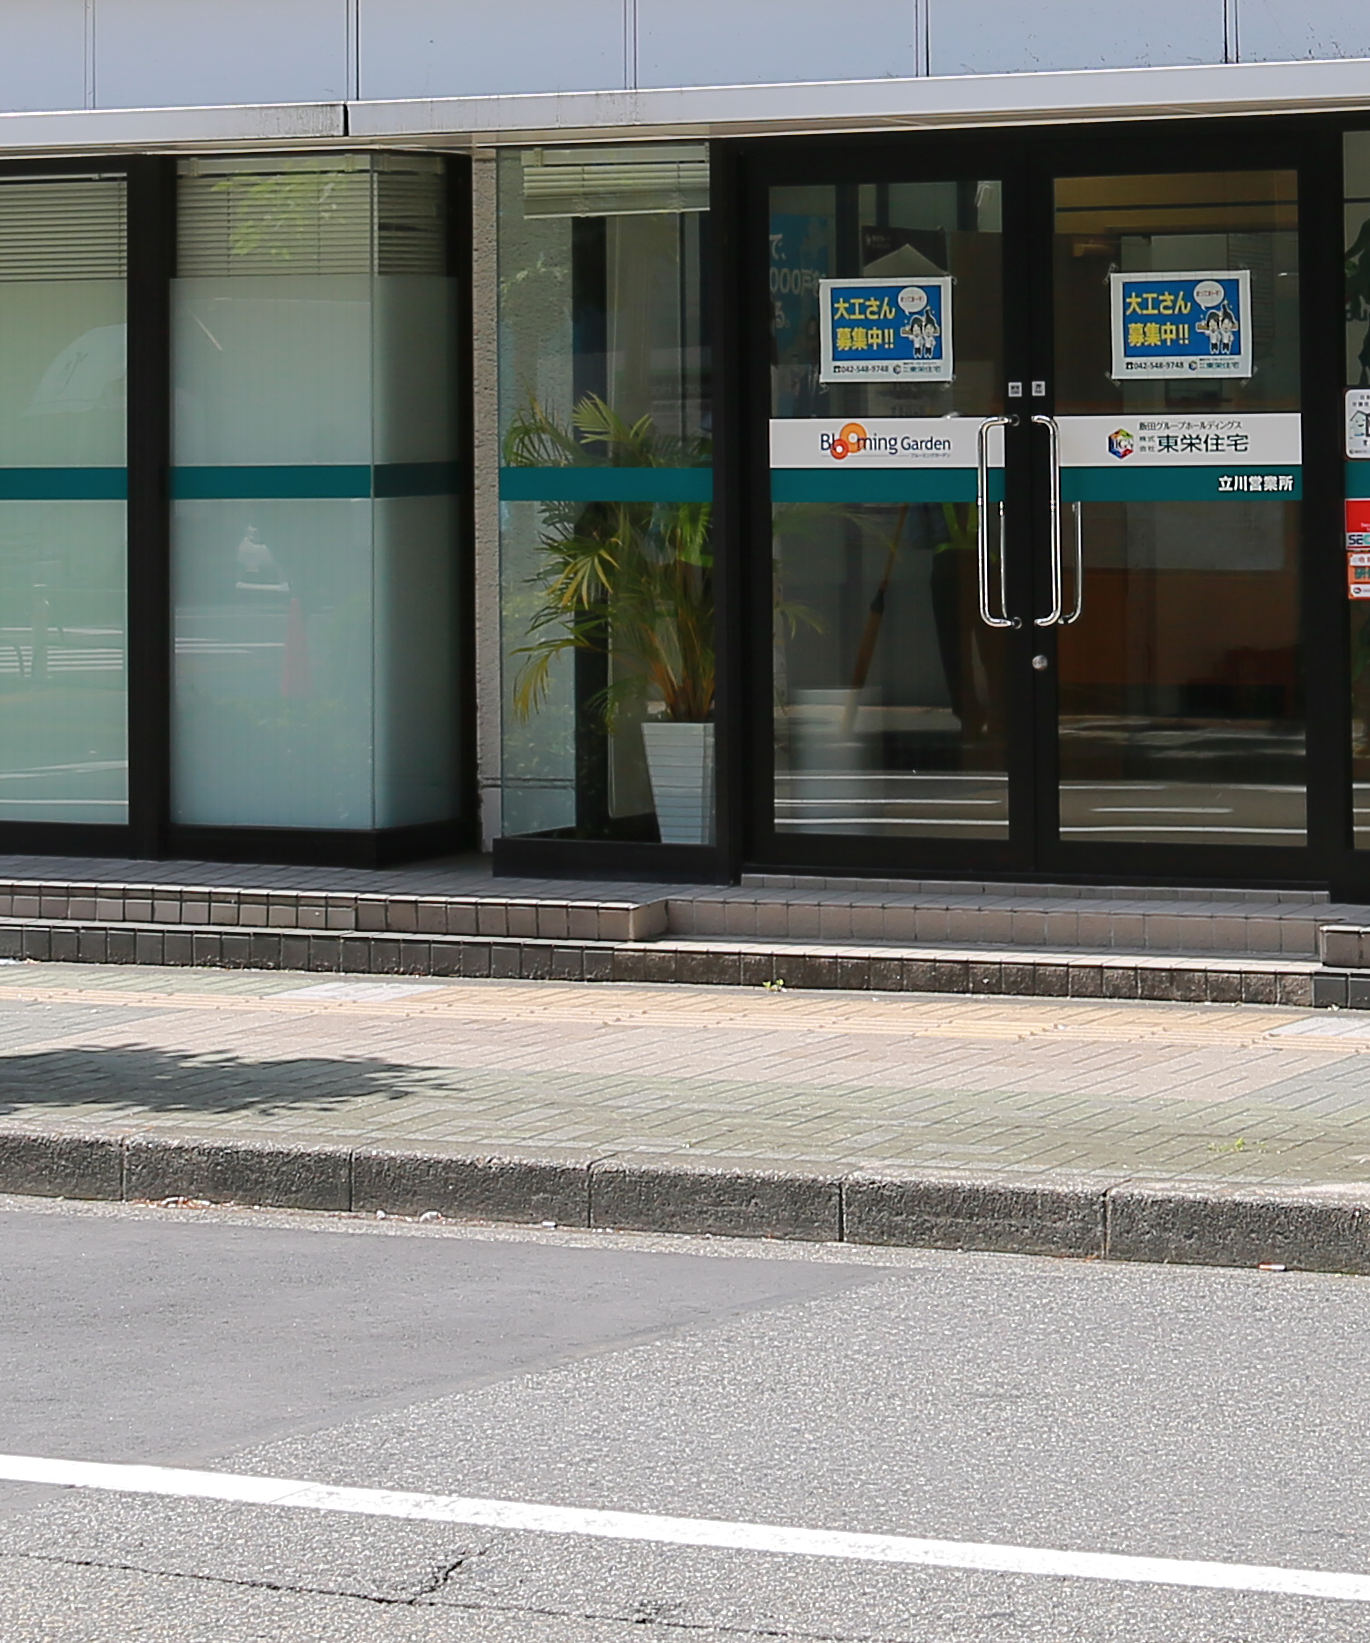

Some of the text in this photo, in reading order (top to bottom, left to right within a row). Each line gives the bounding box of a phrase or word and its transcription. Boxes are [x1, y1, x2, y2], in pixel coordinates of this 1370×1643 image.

[834, 297, 895, 320] 大工さん
[1126, 292, 1191, 315] 大工さん
[836, 328, 894, 350] 募集中!!
[1128, 323, 1189, 346] 募集中!!
[841, 365, 889, 373] 042-548-9748
[1134, 361, 1184, 370] 042-548-9748
[1139, 421, 1242, 431] 飯田グループホールディングス
[901, 436, 951, 451] Garden
[1157, 434, 1249, 453] 東栄住宅
[1218, 475, 1294, 492] 立川営業所
